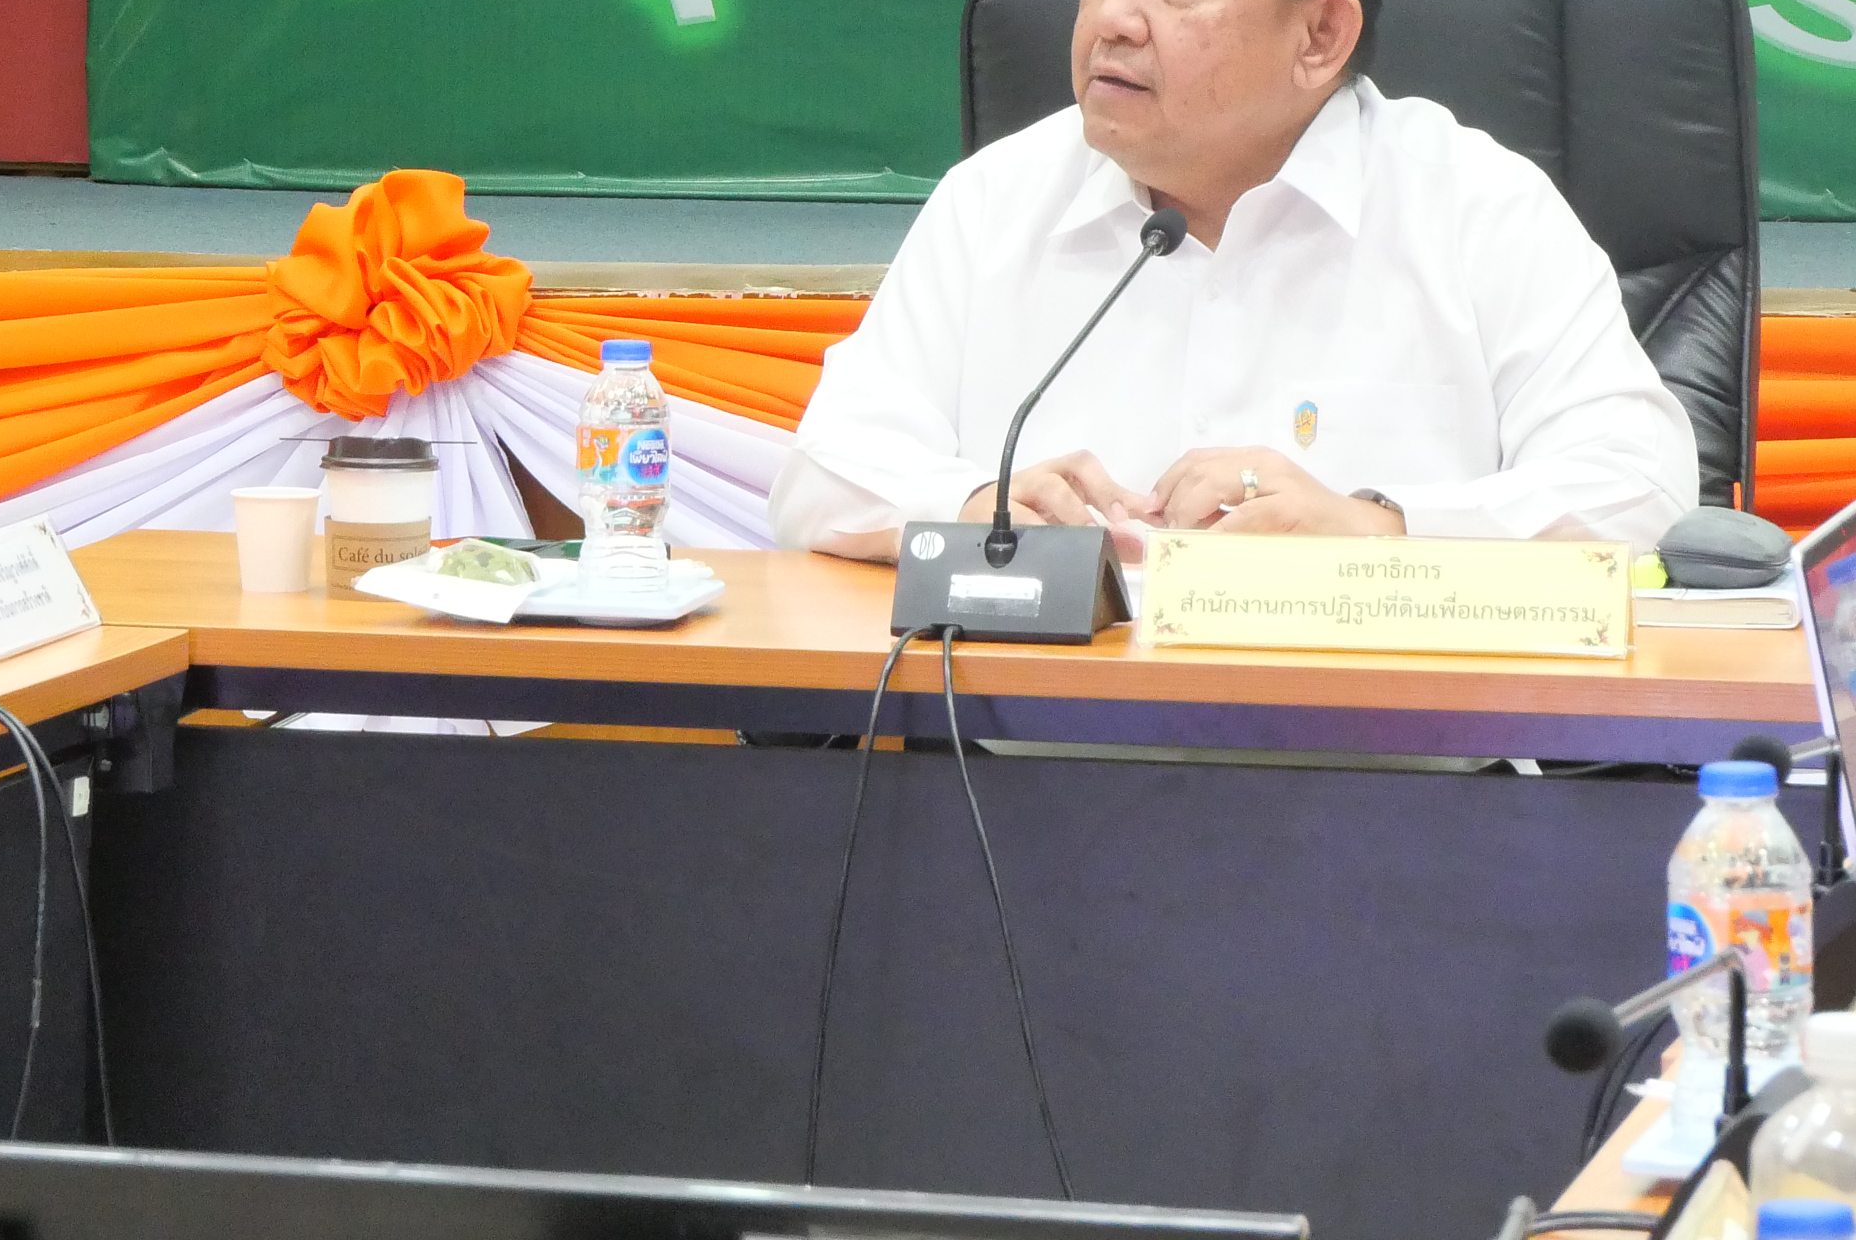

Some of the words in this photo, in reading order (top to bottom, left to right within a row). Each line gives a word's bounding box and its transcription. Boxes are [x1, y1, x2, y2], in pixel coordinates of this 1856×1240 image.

[338, 546, 370, 564] Café
[374, 548, 394, 564] du
[1337, 556, 1443, 581] เลขาธิการ
[1179, 588, 1598, 625] สำนักงานการปฏิรูปที่ดินเพื่อเกษตรกรรม
